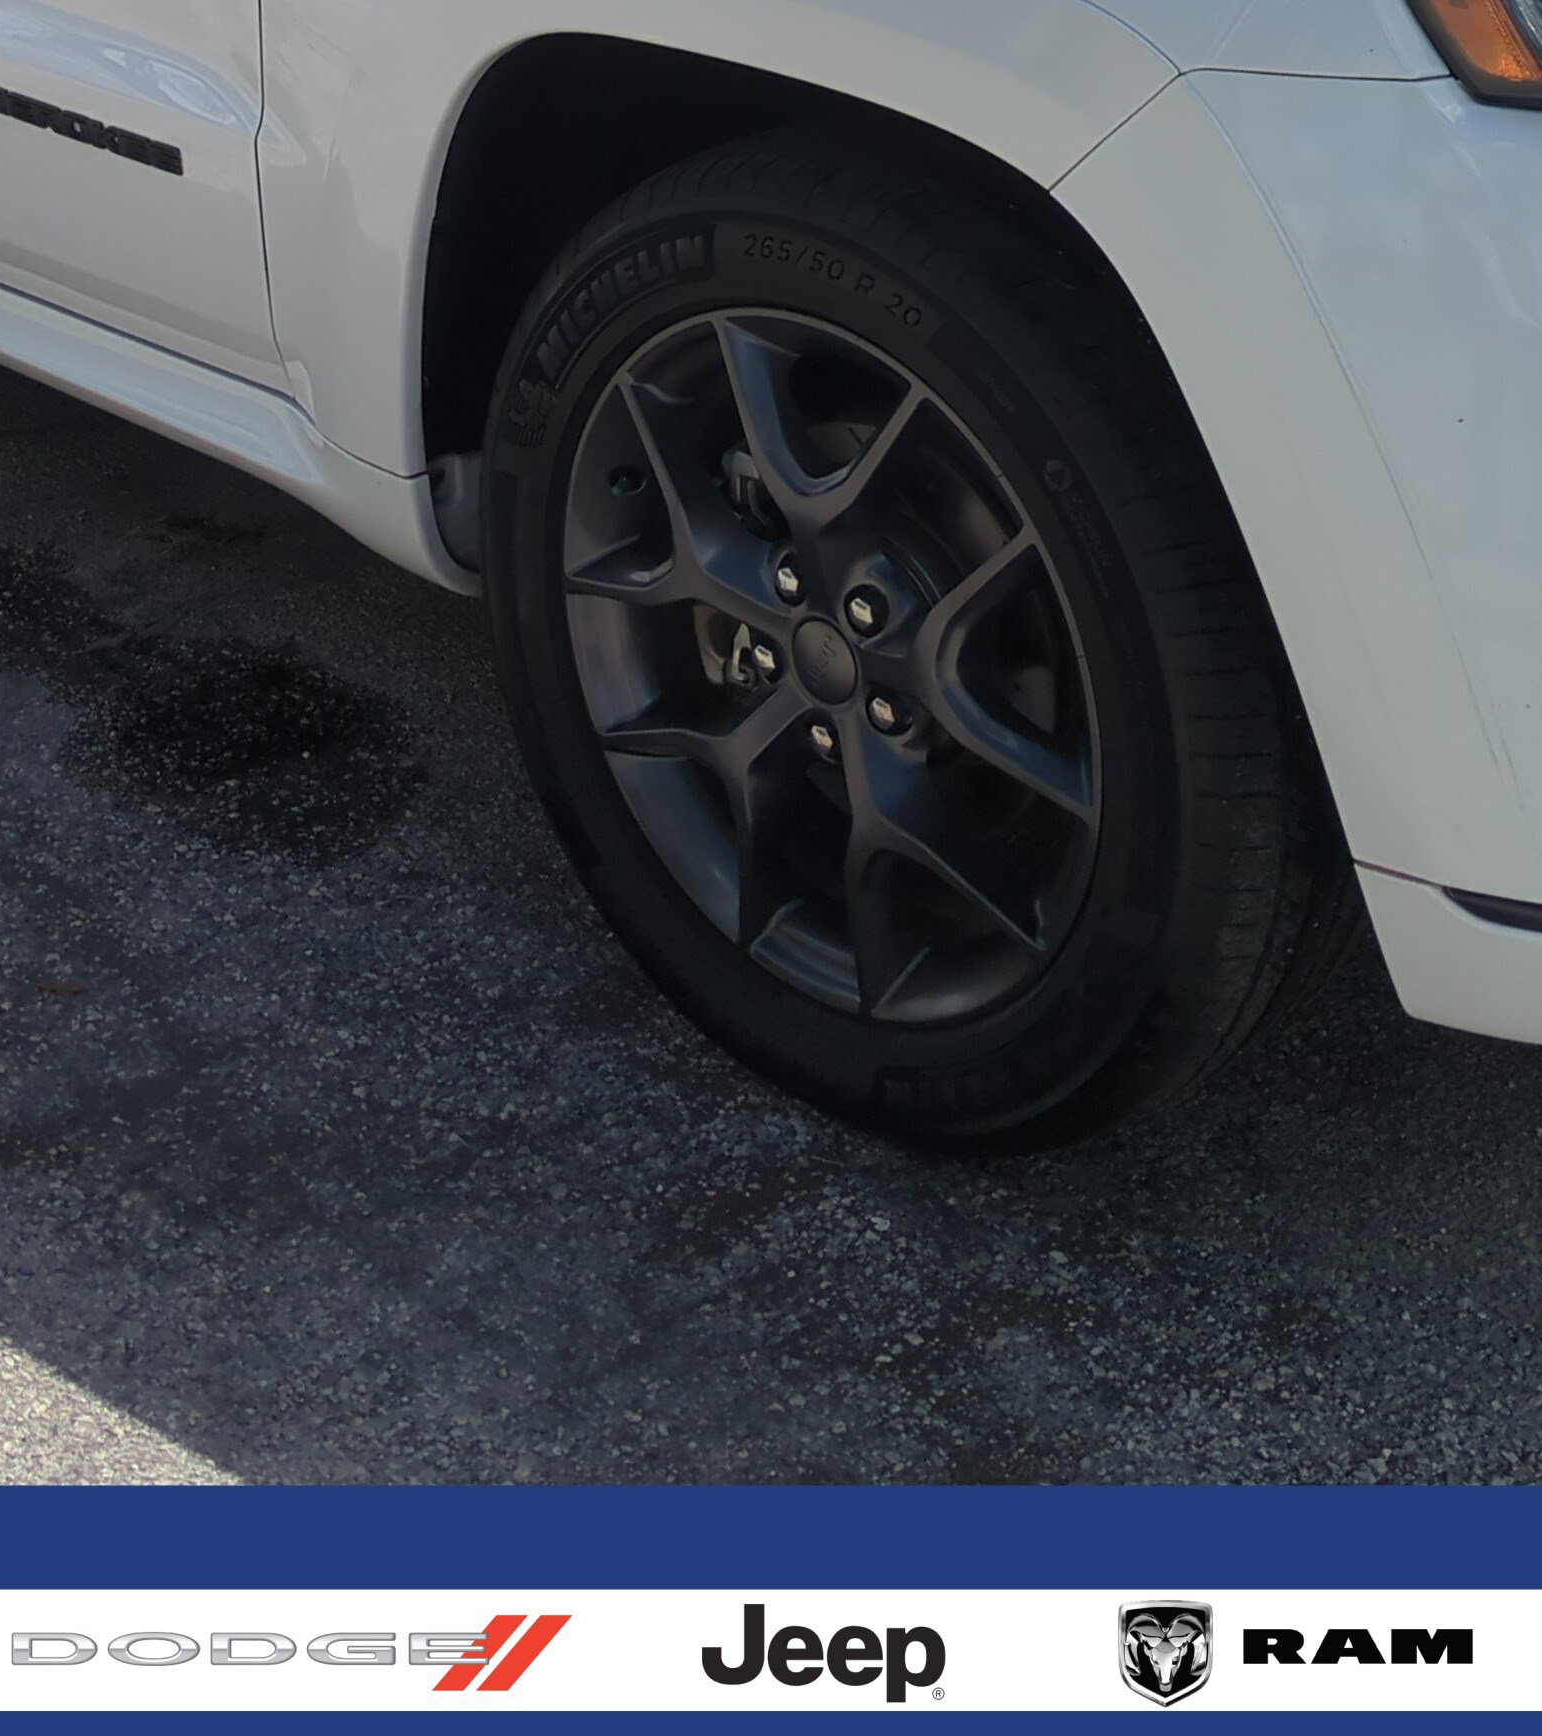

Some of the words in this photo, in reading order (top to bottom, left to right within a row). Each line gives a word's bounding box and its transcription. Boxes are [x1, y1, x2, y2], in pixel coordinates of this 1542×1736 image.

[537, 235, 705, 381] MICHELIN
[743, 233, 845, 281] 265/50
[854, 272, 876, 296] R
[884, 292, 922, 326] 20
